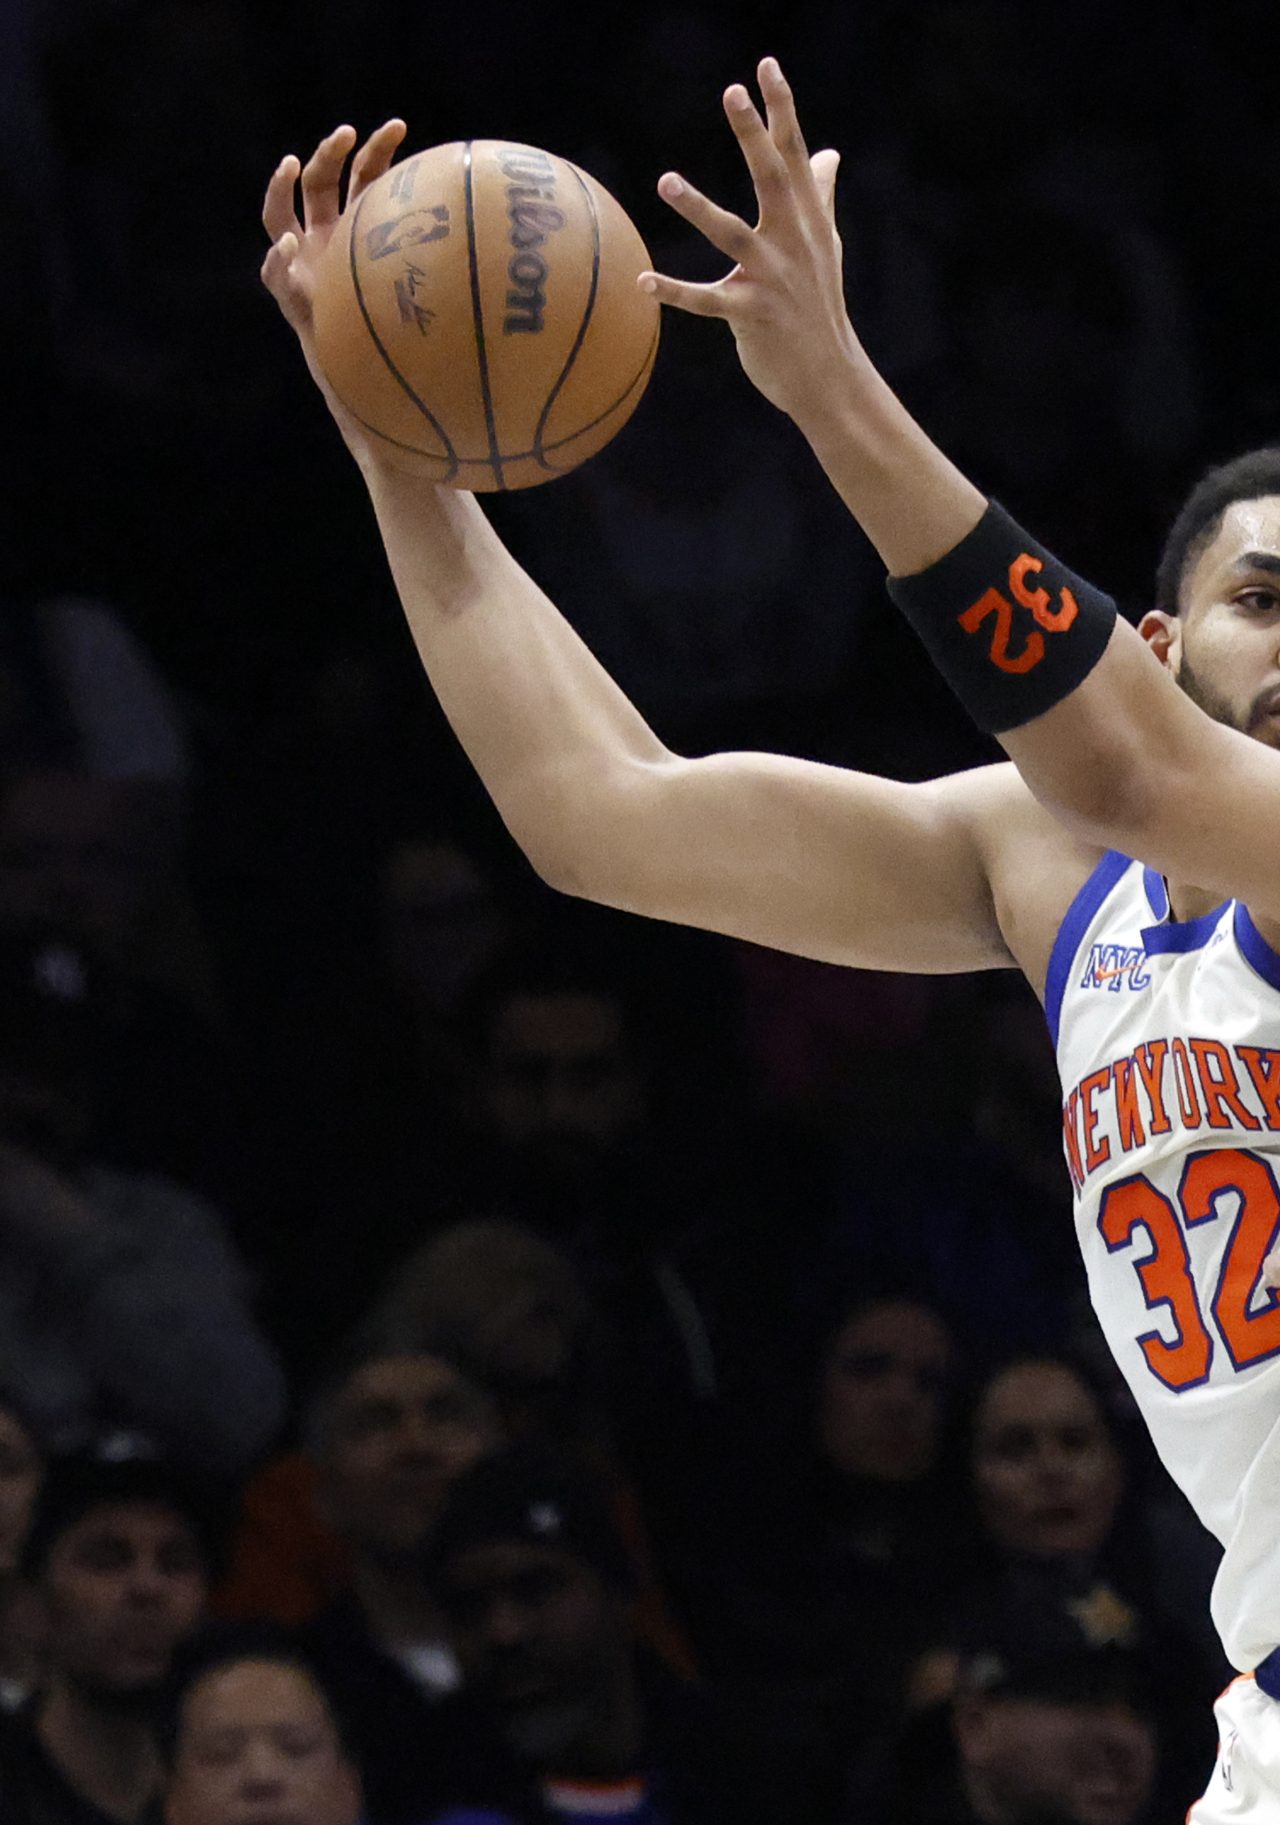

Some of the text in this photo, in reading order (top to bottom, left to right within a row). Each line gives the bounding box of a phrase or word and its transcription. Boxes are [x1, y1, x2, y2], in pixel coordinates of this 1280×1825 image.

[496, 150, 566, 337] Wilson
[957, 553, 1080, 674] 32
[1080, 944, 1151, 992] NYC
